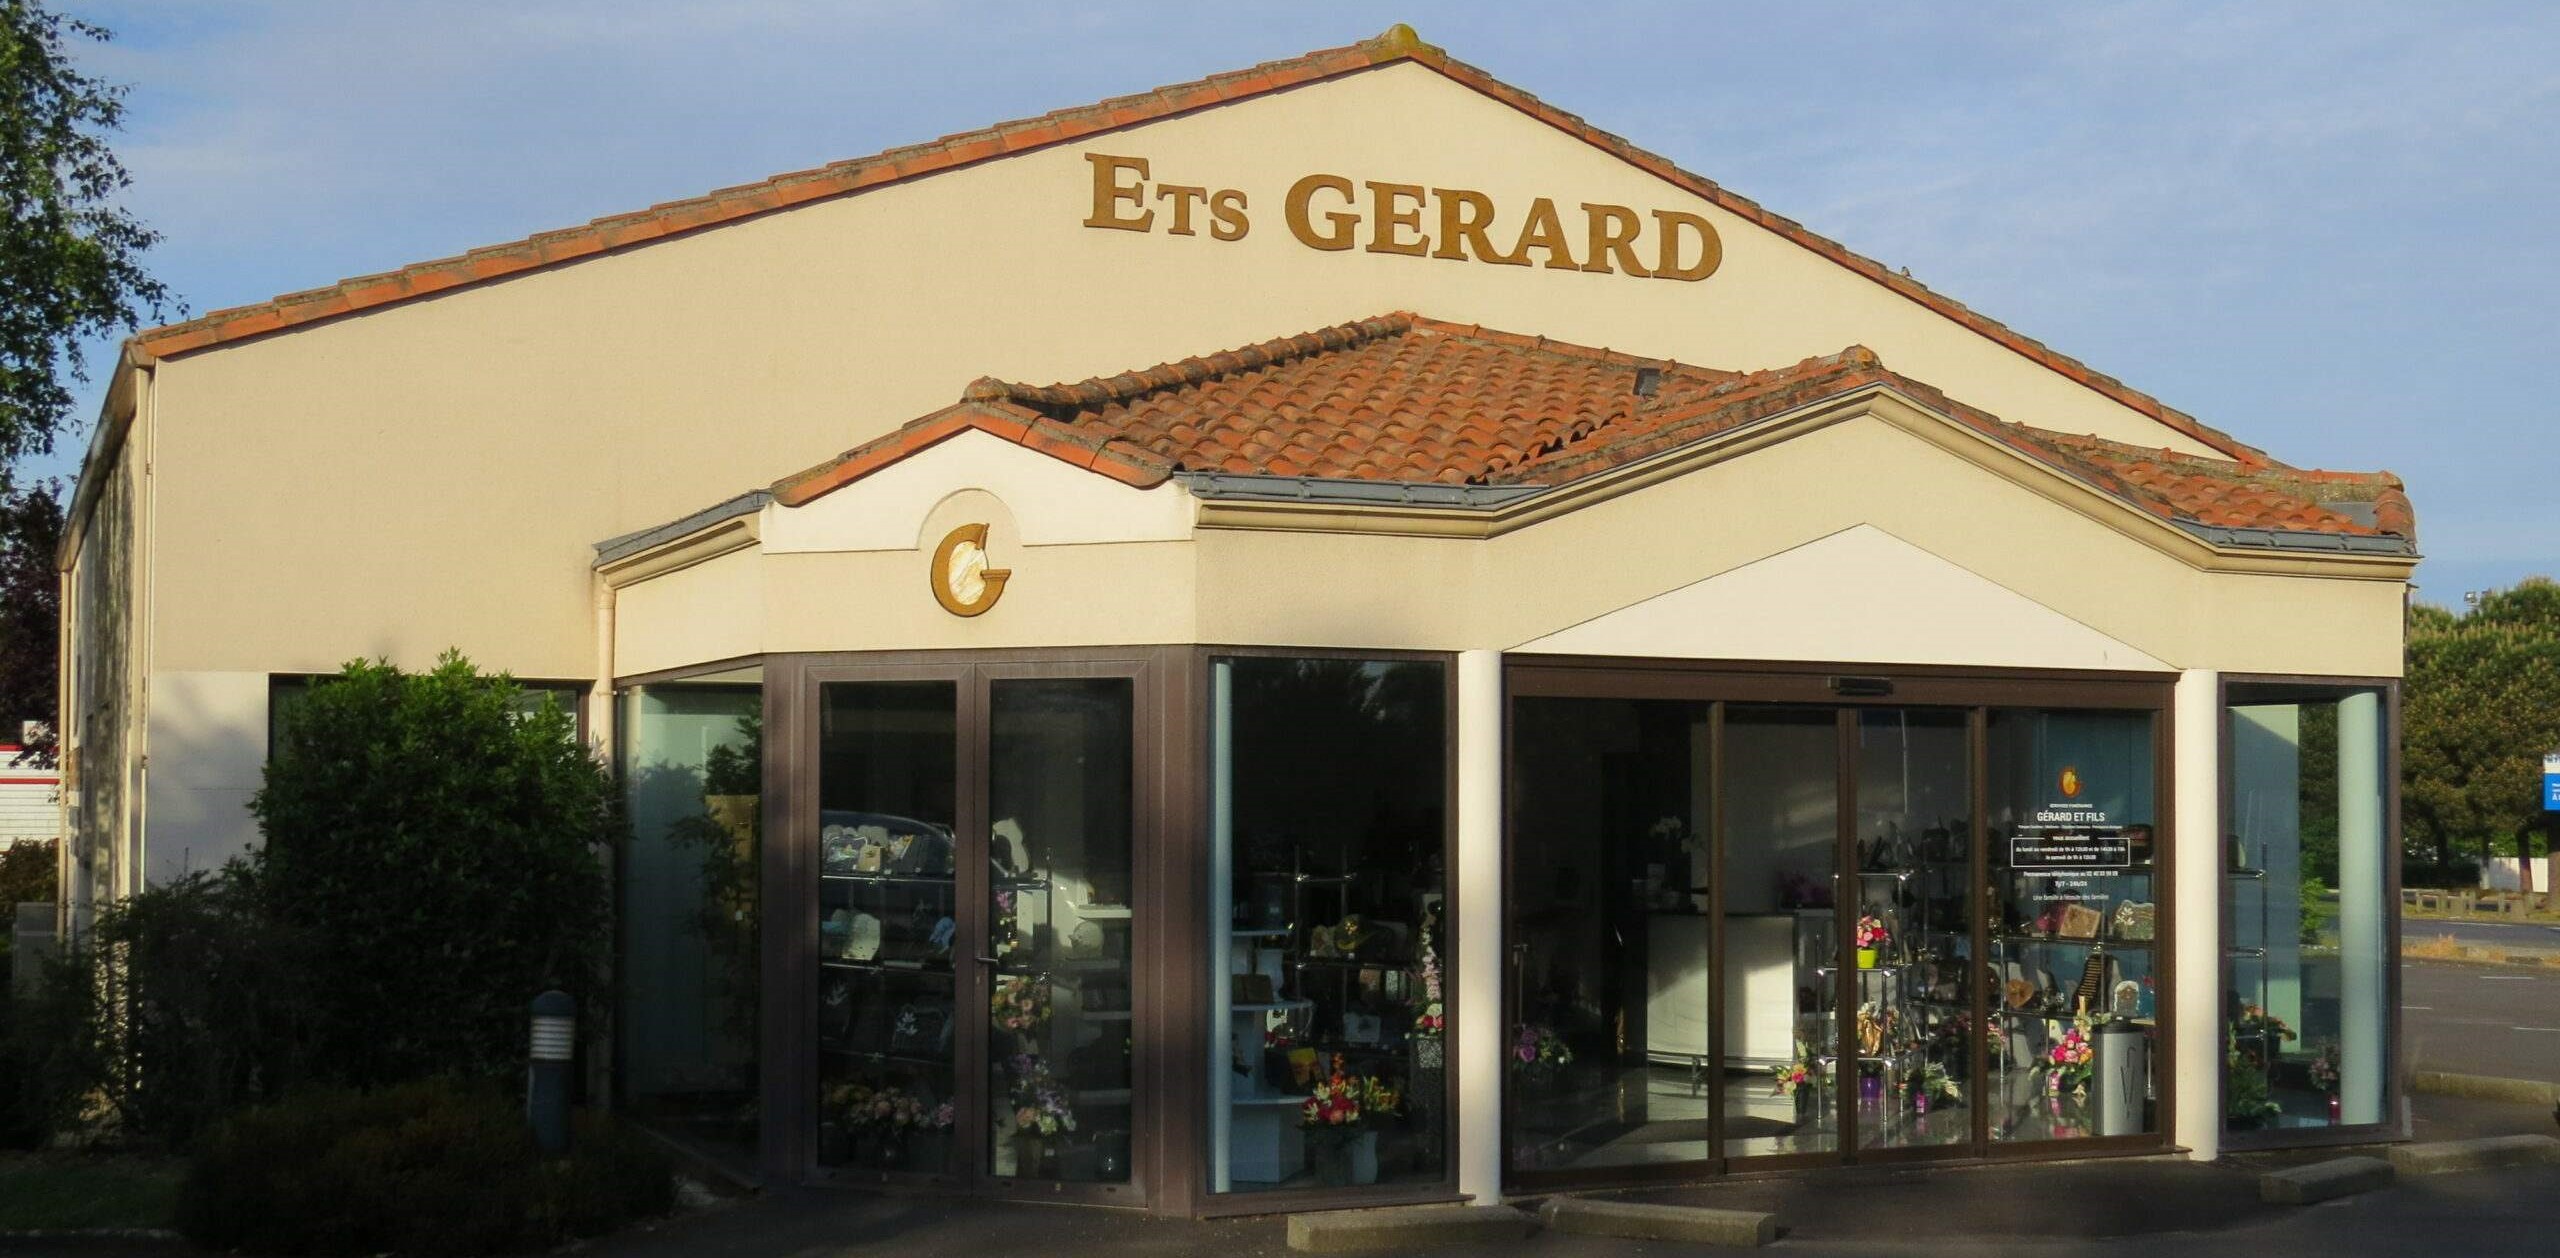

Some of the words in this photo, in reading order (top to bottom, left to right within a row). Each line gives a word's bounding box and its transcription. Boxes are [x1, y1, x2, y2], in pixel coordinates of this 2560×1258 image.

[1284, 173, 1723, 282] GERARD
[2036, 809, 2073, 822] GÉRARD
[2073, 812, 2085, 822] ET
[2086, 812, 2105, 822] FILS
